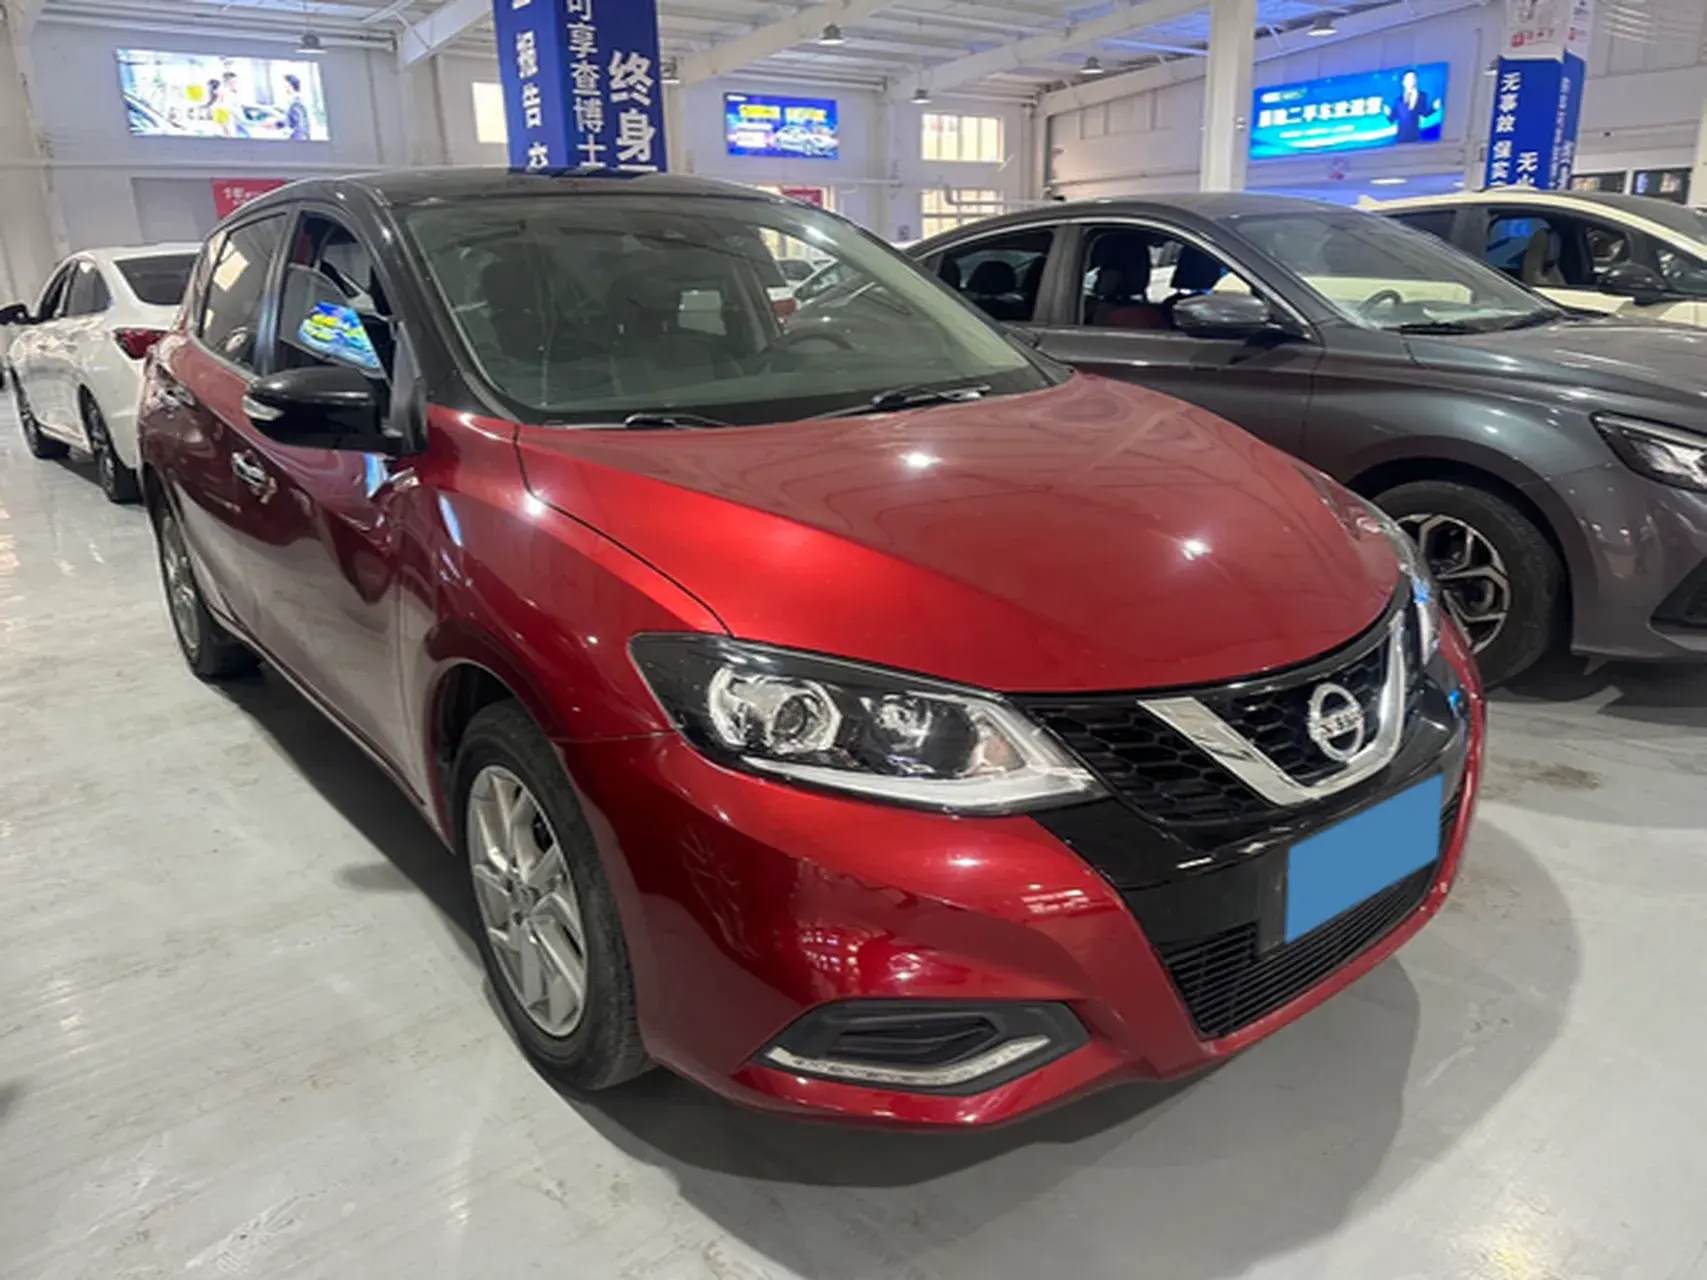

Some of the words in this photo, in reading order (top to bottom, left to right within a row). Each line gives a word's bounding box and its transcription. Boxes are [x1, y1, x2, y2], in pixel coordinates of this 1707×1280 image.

[566, 0, 606, 168] 可享查博士
[607, 50, 658, 171] 终身
